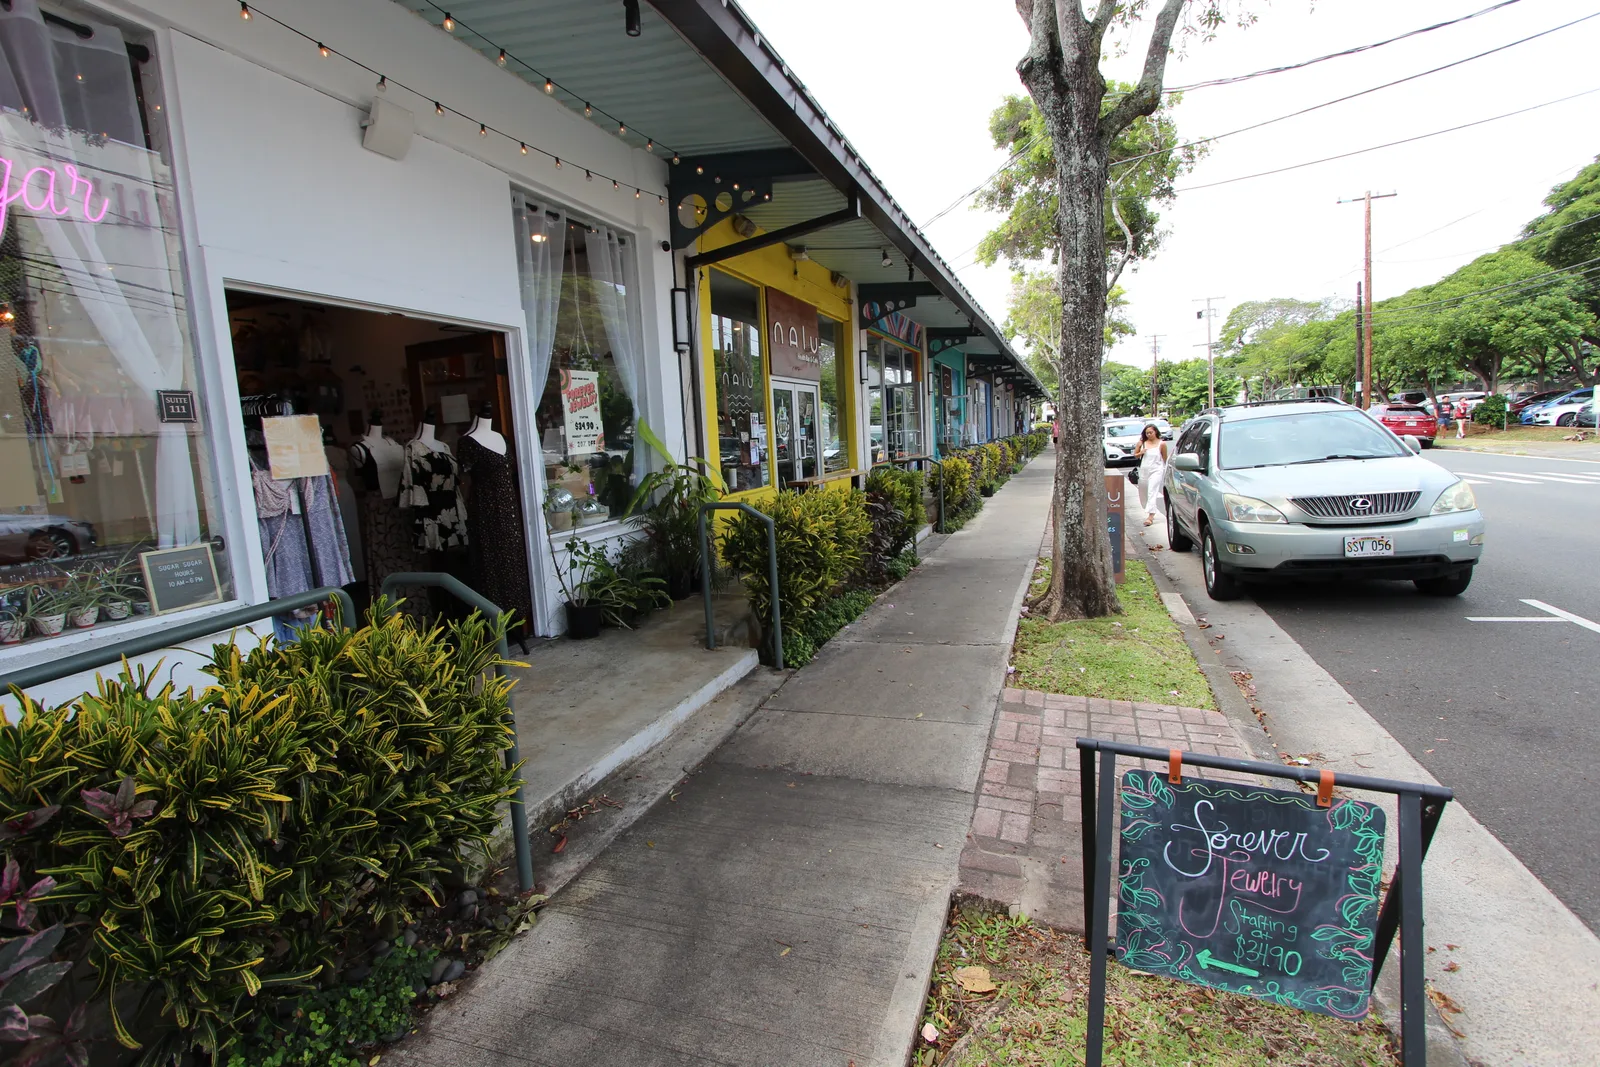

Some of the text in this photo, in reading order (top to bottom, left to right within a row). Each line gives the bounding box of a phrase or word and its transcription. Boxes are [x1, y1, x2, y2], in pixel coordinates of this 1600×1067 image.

[567, 382, 595, 402] FOREVER
[169, 405, 187, 413] 111
[569, 394, 597, 413] JEWELRY
[1347, 540, 1391, 552] SSV 056
[158, 559, 204, 572] SUGAR SUGAR
[174, 569, 195, 578] HOURS
[1163, 799, 1331, 878] Forever
[1223, 899, 1298, 942] Starting
[1250, 929, 1274, 941] at
